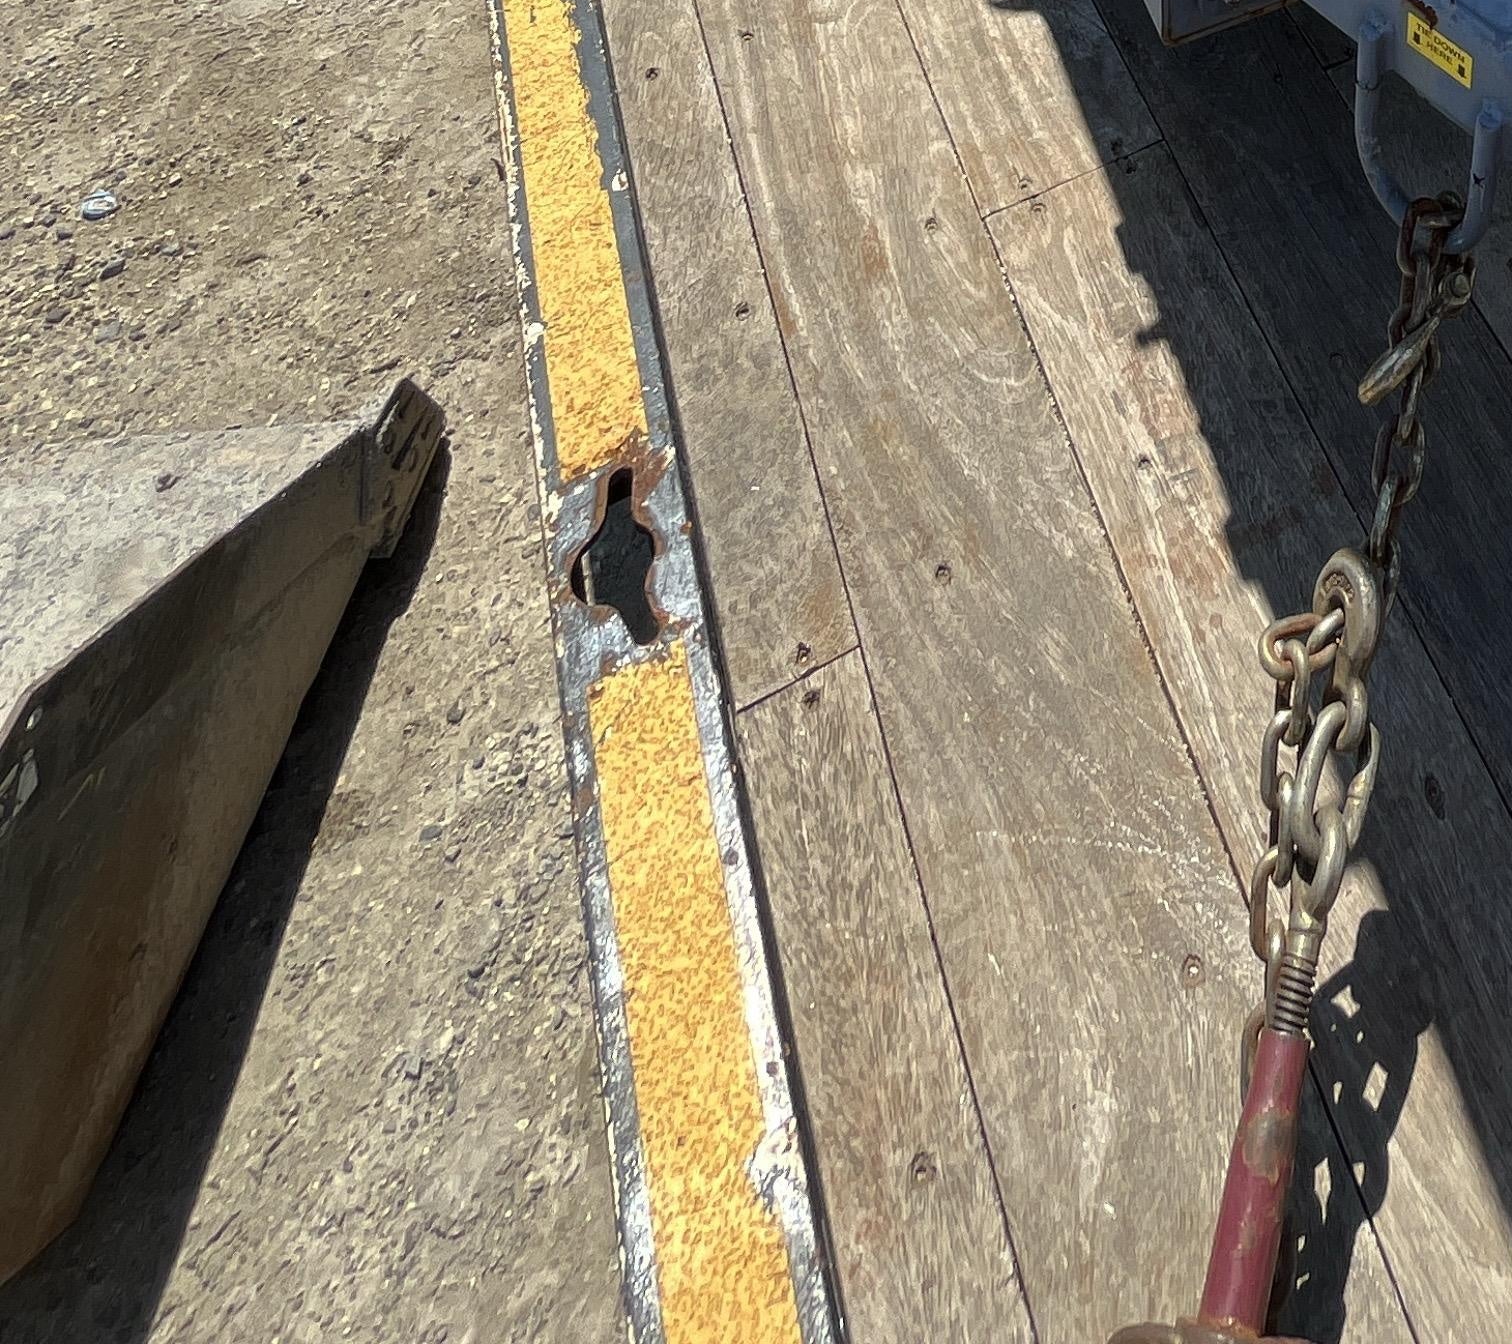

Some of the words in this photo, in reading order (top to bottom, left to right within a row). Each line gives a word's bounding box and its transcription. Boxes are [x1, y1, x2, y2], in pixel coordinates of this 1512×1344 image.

[1416, 22, 1433, 39] TIE
[1433, 35, 1466, 64] DOWN
[1426, 40, 1454, 66] HERE
